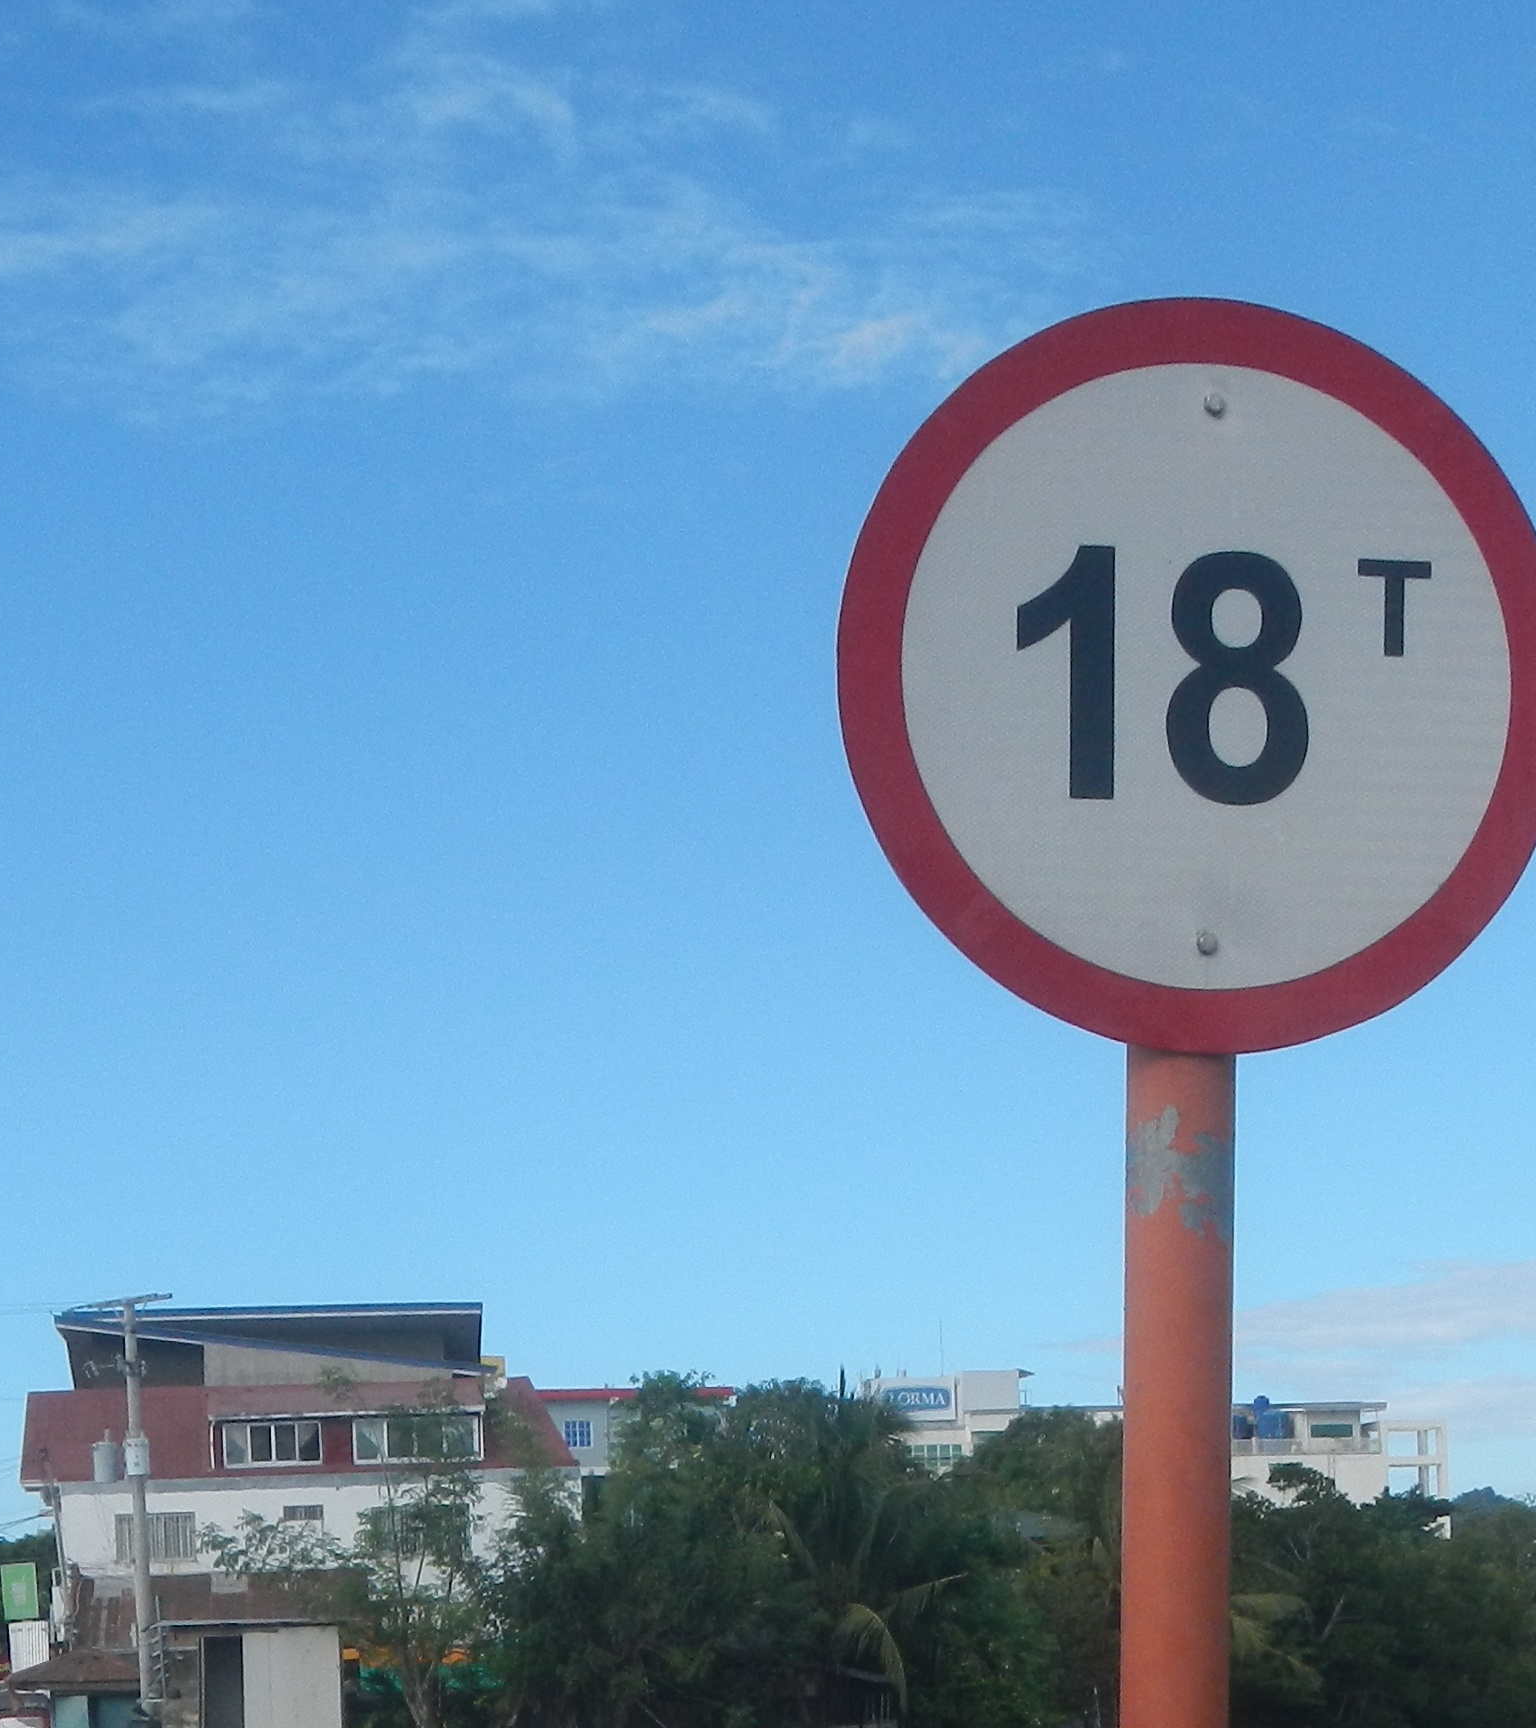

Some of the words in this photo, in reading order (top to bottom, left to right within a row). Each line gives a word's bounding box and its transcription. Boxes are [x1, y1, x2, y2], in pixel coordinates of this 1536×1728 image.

[1017, 545, 1309, 805] 18
[1358, 559, 1432, 657] T
[888, 1391, 946, 1406] LORMA
